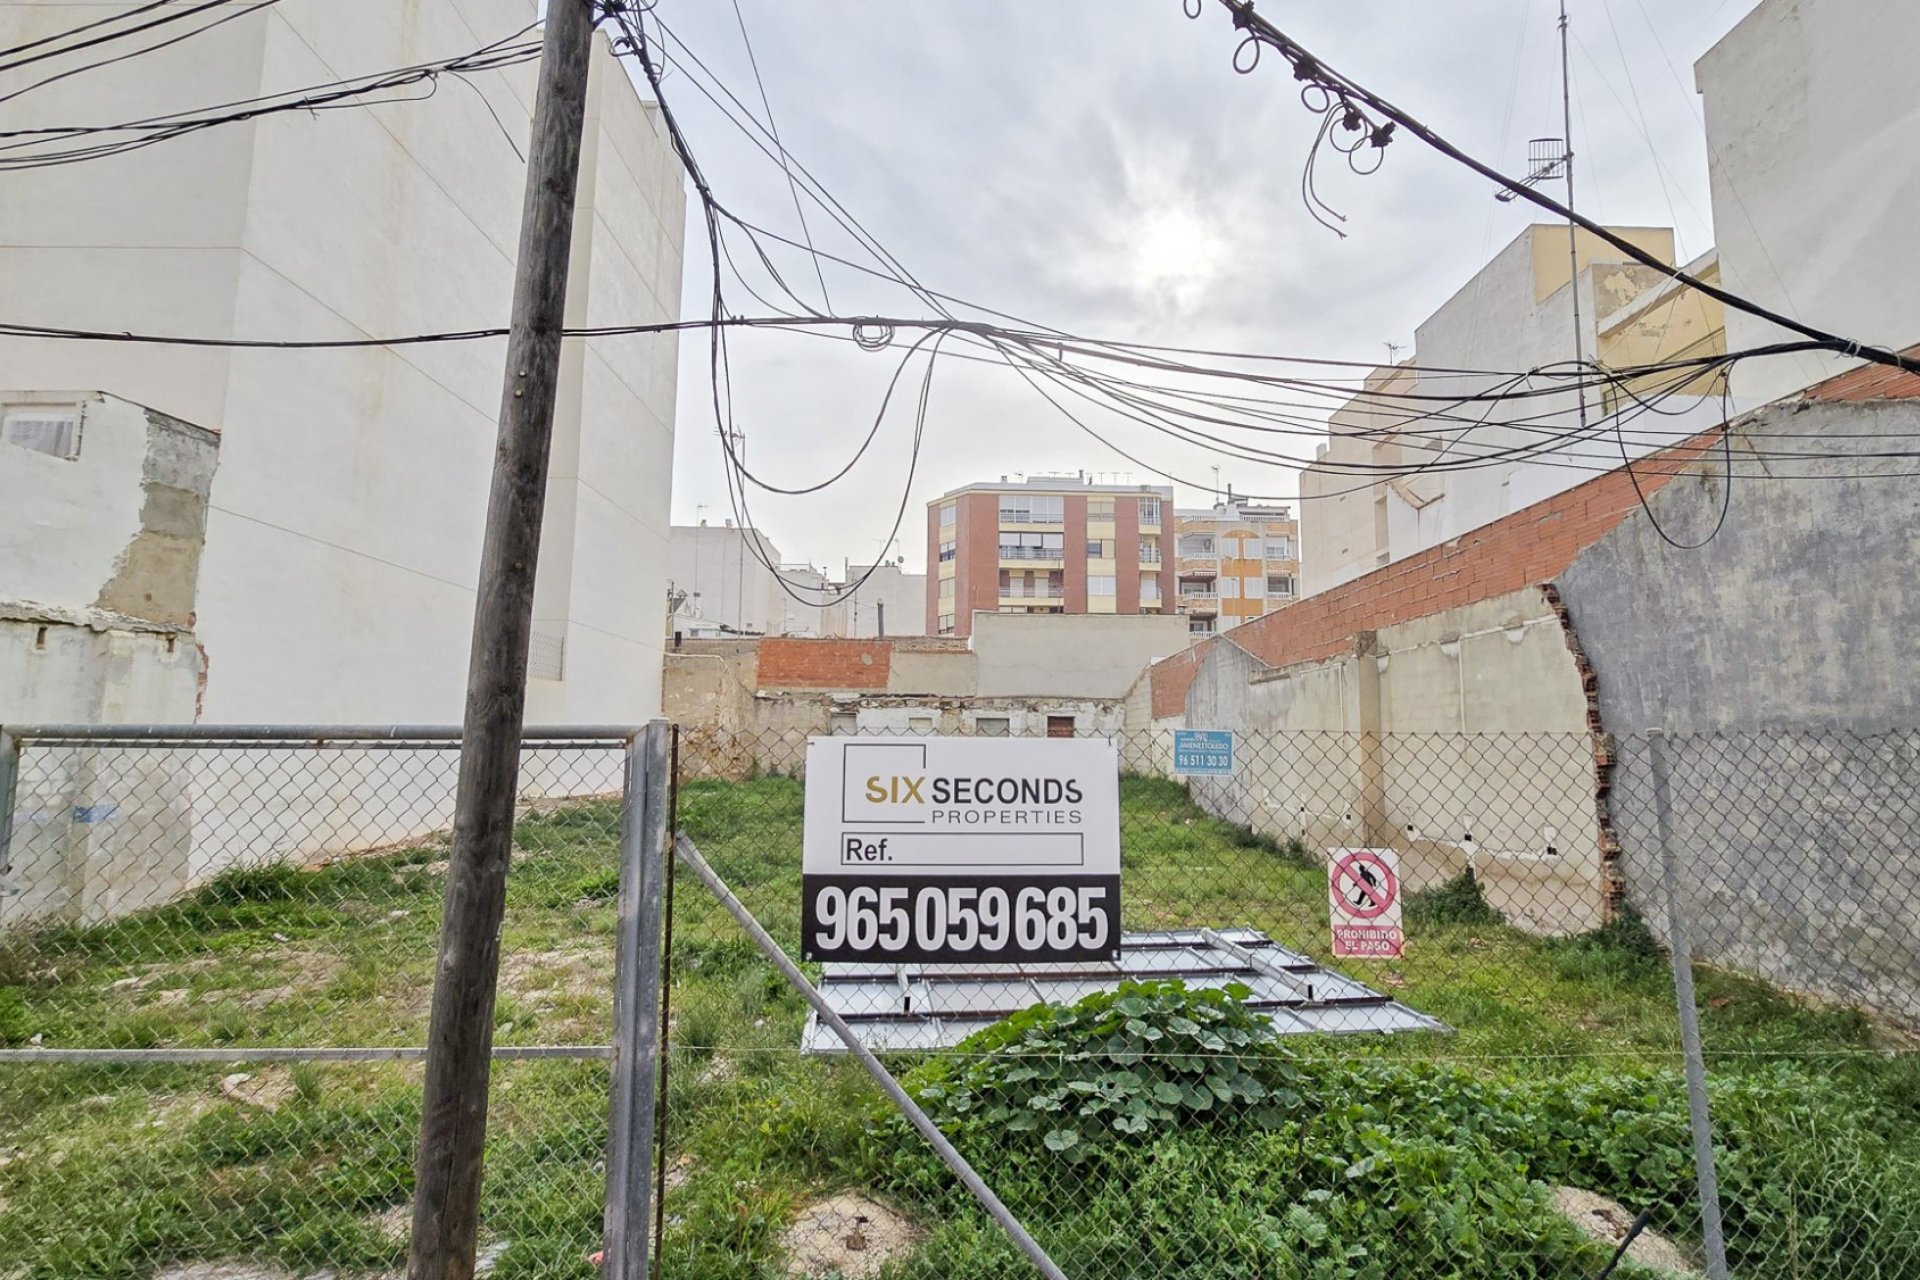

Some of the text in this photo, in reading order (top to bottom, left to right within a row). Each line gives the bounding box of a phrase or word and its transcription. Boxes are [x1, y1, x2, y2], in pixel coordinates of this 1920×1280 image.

[1178, 754, 1228, 766] 96 511 30 30
[866, 775, 1083, 804] SIX SECONDS
[932, 810, 1082, 824] PROPERTIES
[846, 838, 893, 861] Ref.
[815, 886, 1109, 951] 965 059 685
[1337, 929, 1397, 940] PROHIBIDO
[1344, 940, 1390, 951] EL PASO
